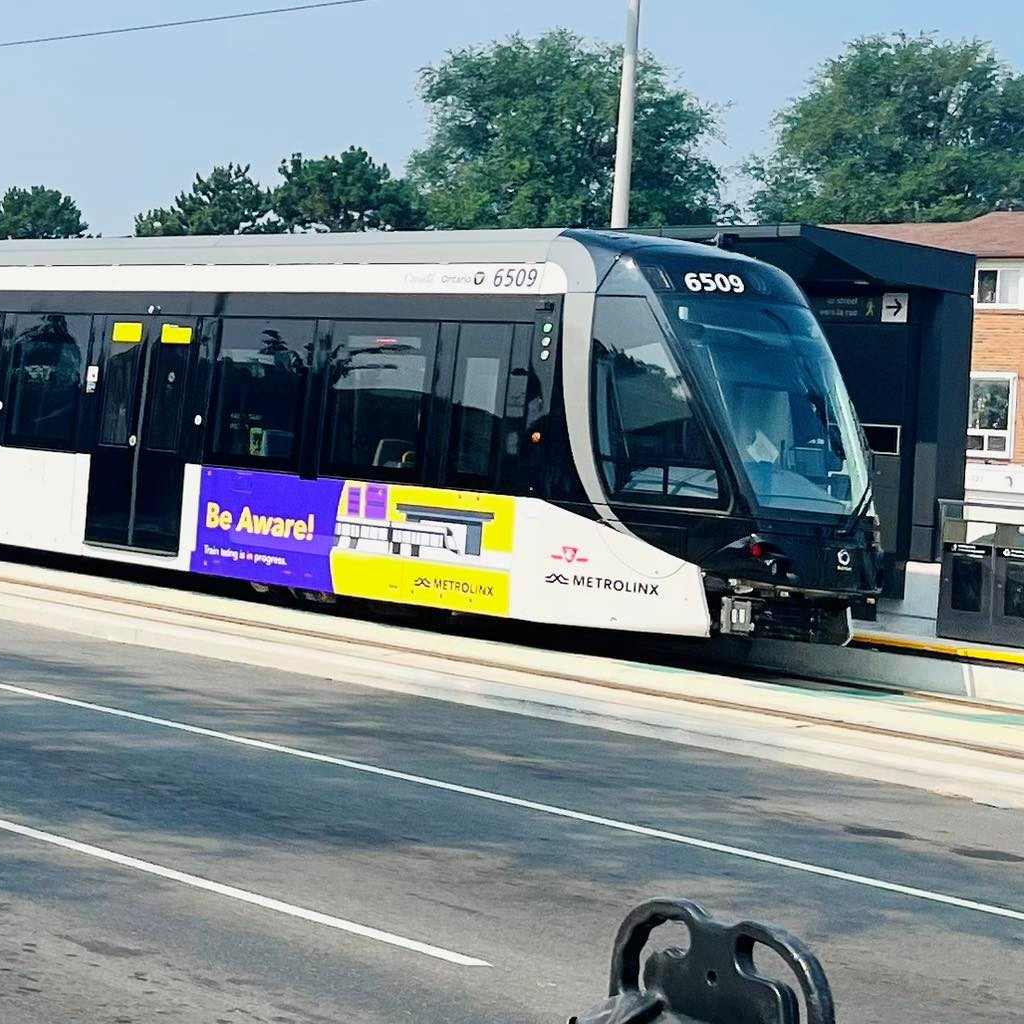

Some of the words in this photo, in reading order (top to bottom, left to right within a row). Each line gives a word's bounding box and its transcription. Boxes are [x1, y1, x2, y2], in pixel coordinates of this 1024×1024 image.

[492, 268, 538, 288] 6509
[684, 271, 745, 294] 6509
[205, 501, 233, 531] Be
[235, 506, 315, 541] Aware!
[203, 543, 220, 555] Train
[238, 549, 246, 560] is
[246, 550, 253, 560] in
[433, 578, 494, 597] METROLINX
[573, 574, 659, 596] METROLINX
